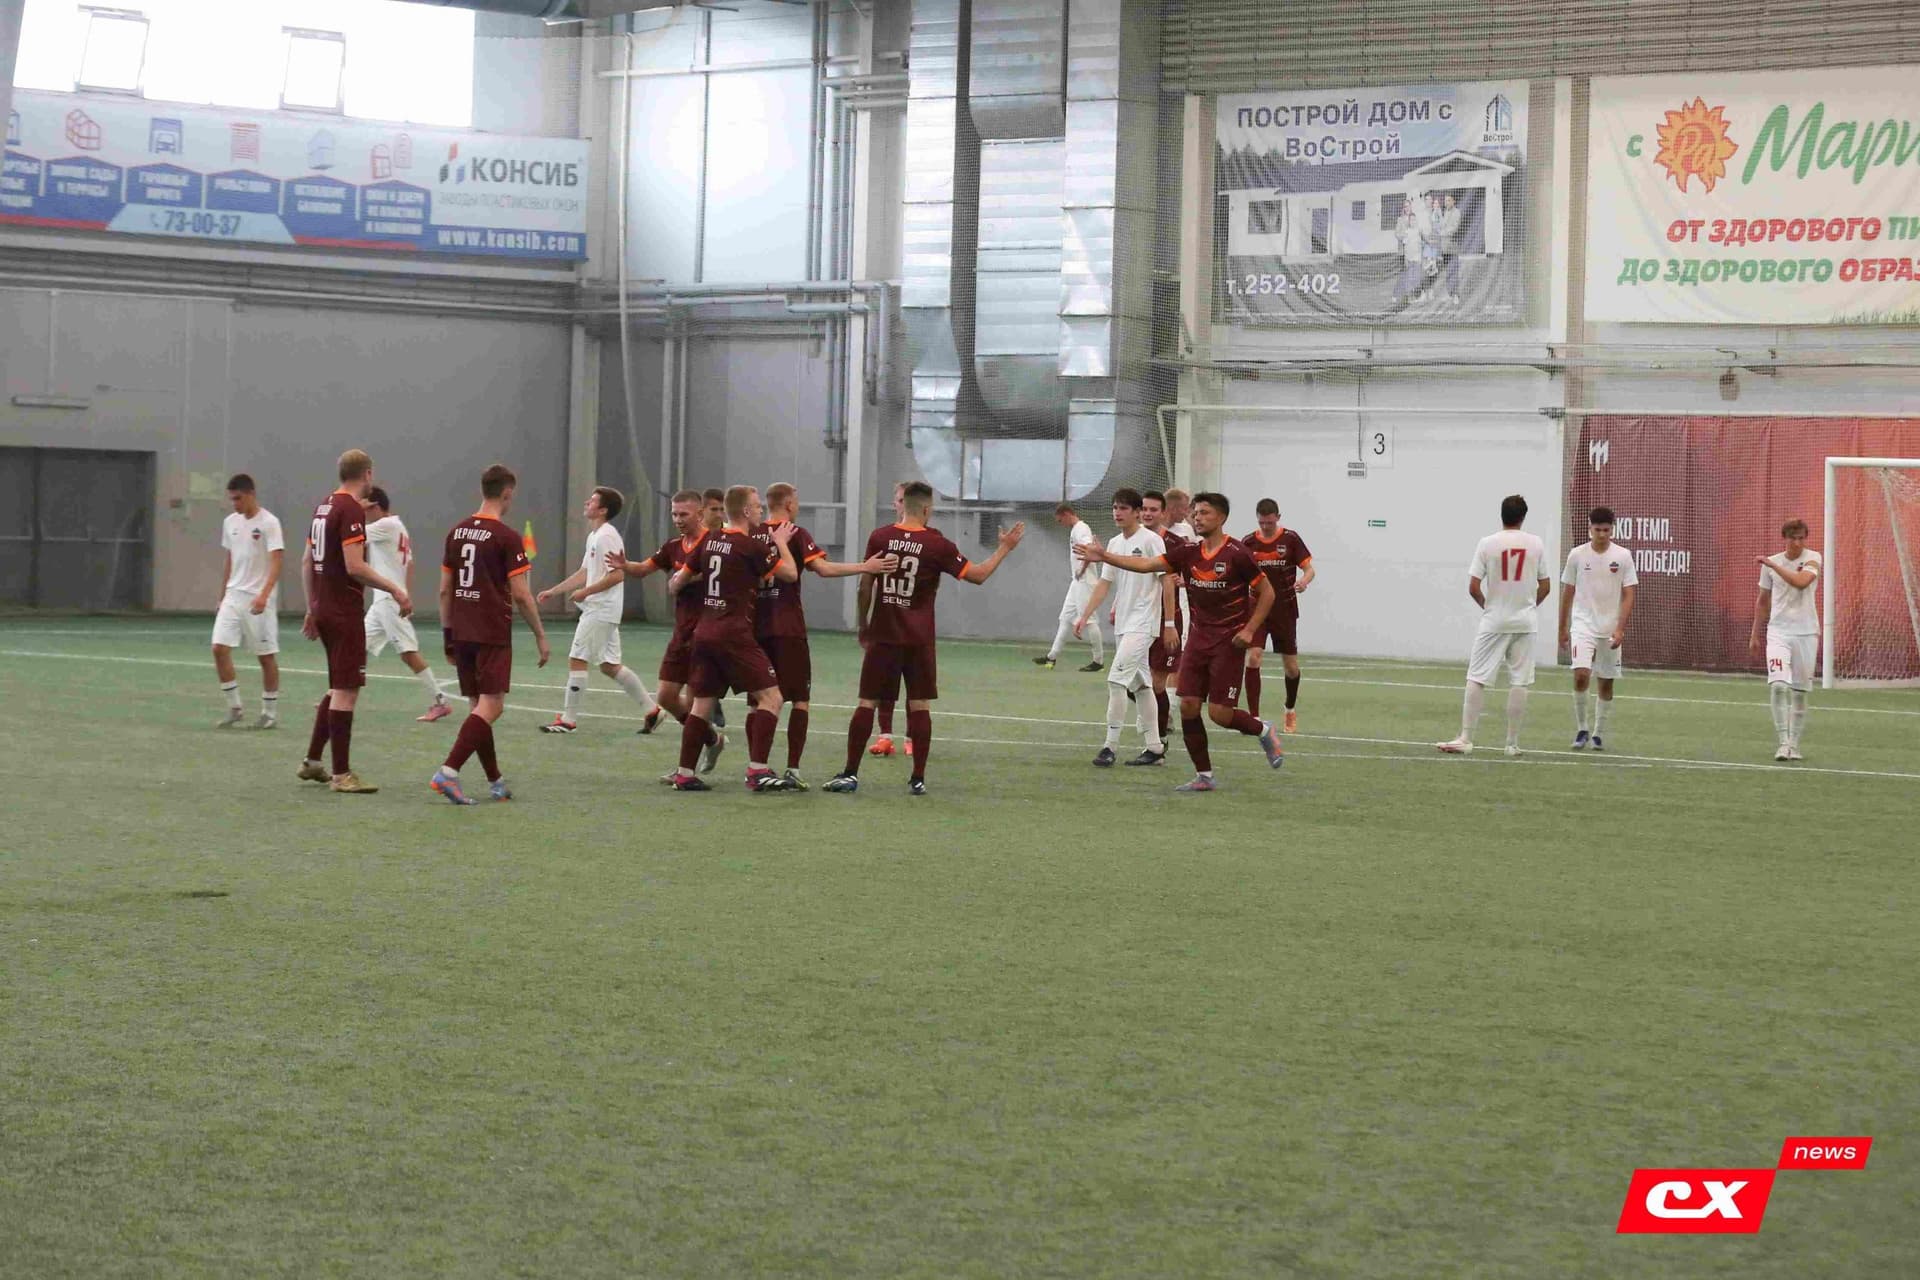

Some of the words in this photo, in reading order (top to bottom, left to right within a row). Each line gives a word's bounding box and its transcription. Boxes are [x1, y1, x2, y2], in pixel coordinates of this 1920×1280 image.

[1237, 98, 1359, 128] ПОСТРОЙ
[1367, 100, 1430, 127] ДОМ
[1285, 133, 1400, 160] ВоСтрой
[471, 156, 579, 187] КОНСИБ
[1666, 219, 1706, 243] ОТ
[1708, 217, 1882, 247] ЗДОРОВОГО
[1617, 258, 1660, 286] ДО
[1663, 258, 1833, 287] ЗДОРОВОГО
[1373, 432, 1385, 455] 3
[1636, 518, 1673, 544] ТЕМП,
[459, 543, 476, 588] 3
[708, 555, 722, 597] 2
[1501, 548, 1527, 582] 17
[1635, 549, 1691, 577] ПОБЕДА!
[1769, 658, 1783, 672] 24
